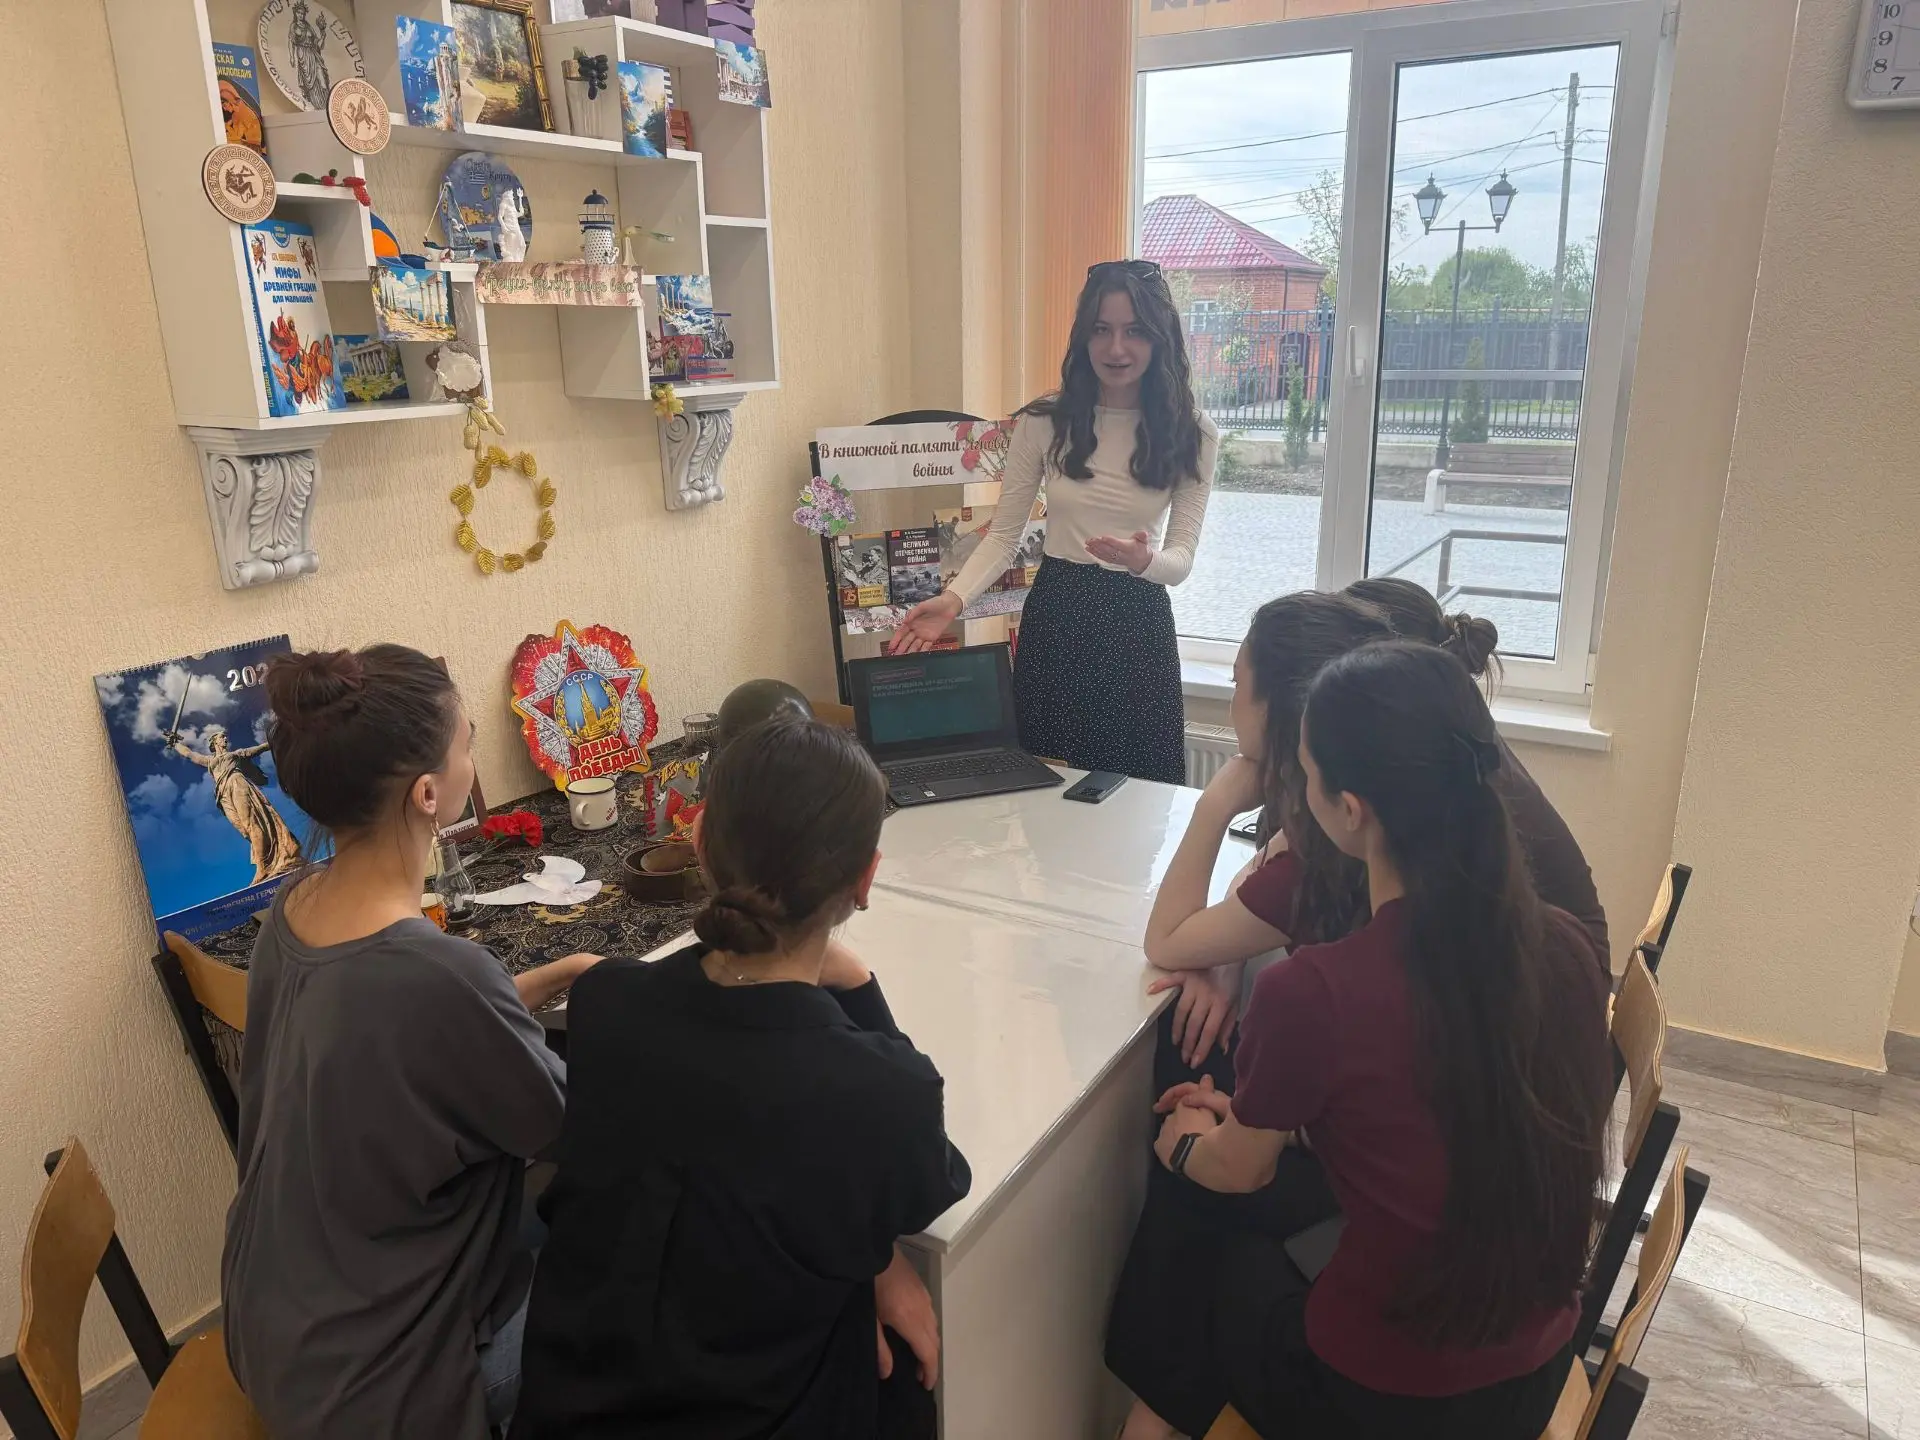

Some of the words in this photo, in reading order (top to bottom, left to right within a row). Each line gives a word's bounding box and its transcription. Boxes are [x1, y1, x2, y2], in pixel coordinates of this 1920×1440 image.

[1882, 3, 1901, 19] 10
[1878, 30, 1893, 46] 9
[1872, 58, 1888, 73] 8
[1890, 76, 1906, 91] 7
[274, 266, 302, 280] МИФЫ
[263, 280, 294, 293] ДРЕВНЕЙ
[293, 282, 317, 293] ГРЕЦИИ
[819, 443, 830, 459] В
[832, 440, 899, 458] книжной
[901, 440, 960, 454] памяти
[912, 461, 954, 477] войны
[902, 540, 930, 548] ВЕЛИКАЯ
[894, 547, 938, 557] ОТЕЧЕСТВЕННАЯ
[907, 555, 927, 563] ВОЙНА
[226, 662, 269, 692] 202
[566, 673, 594, 686] СССР
[578, 736, 622, 763] ДЕНЬ
[568, 746, 642, 782] ПОБЕДЫ!
